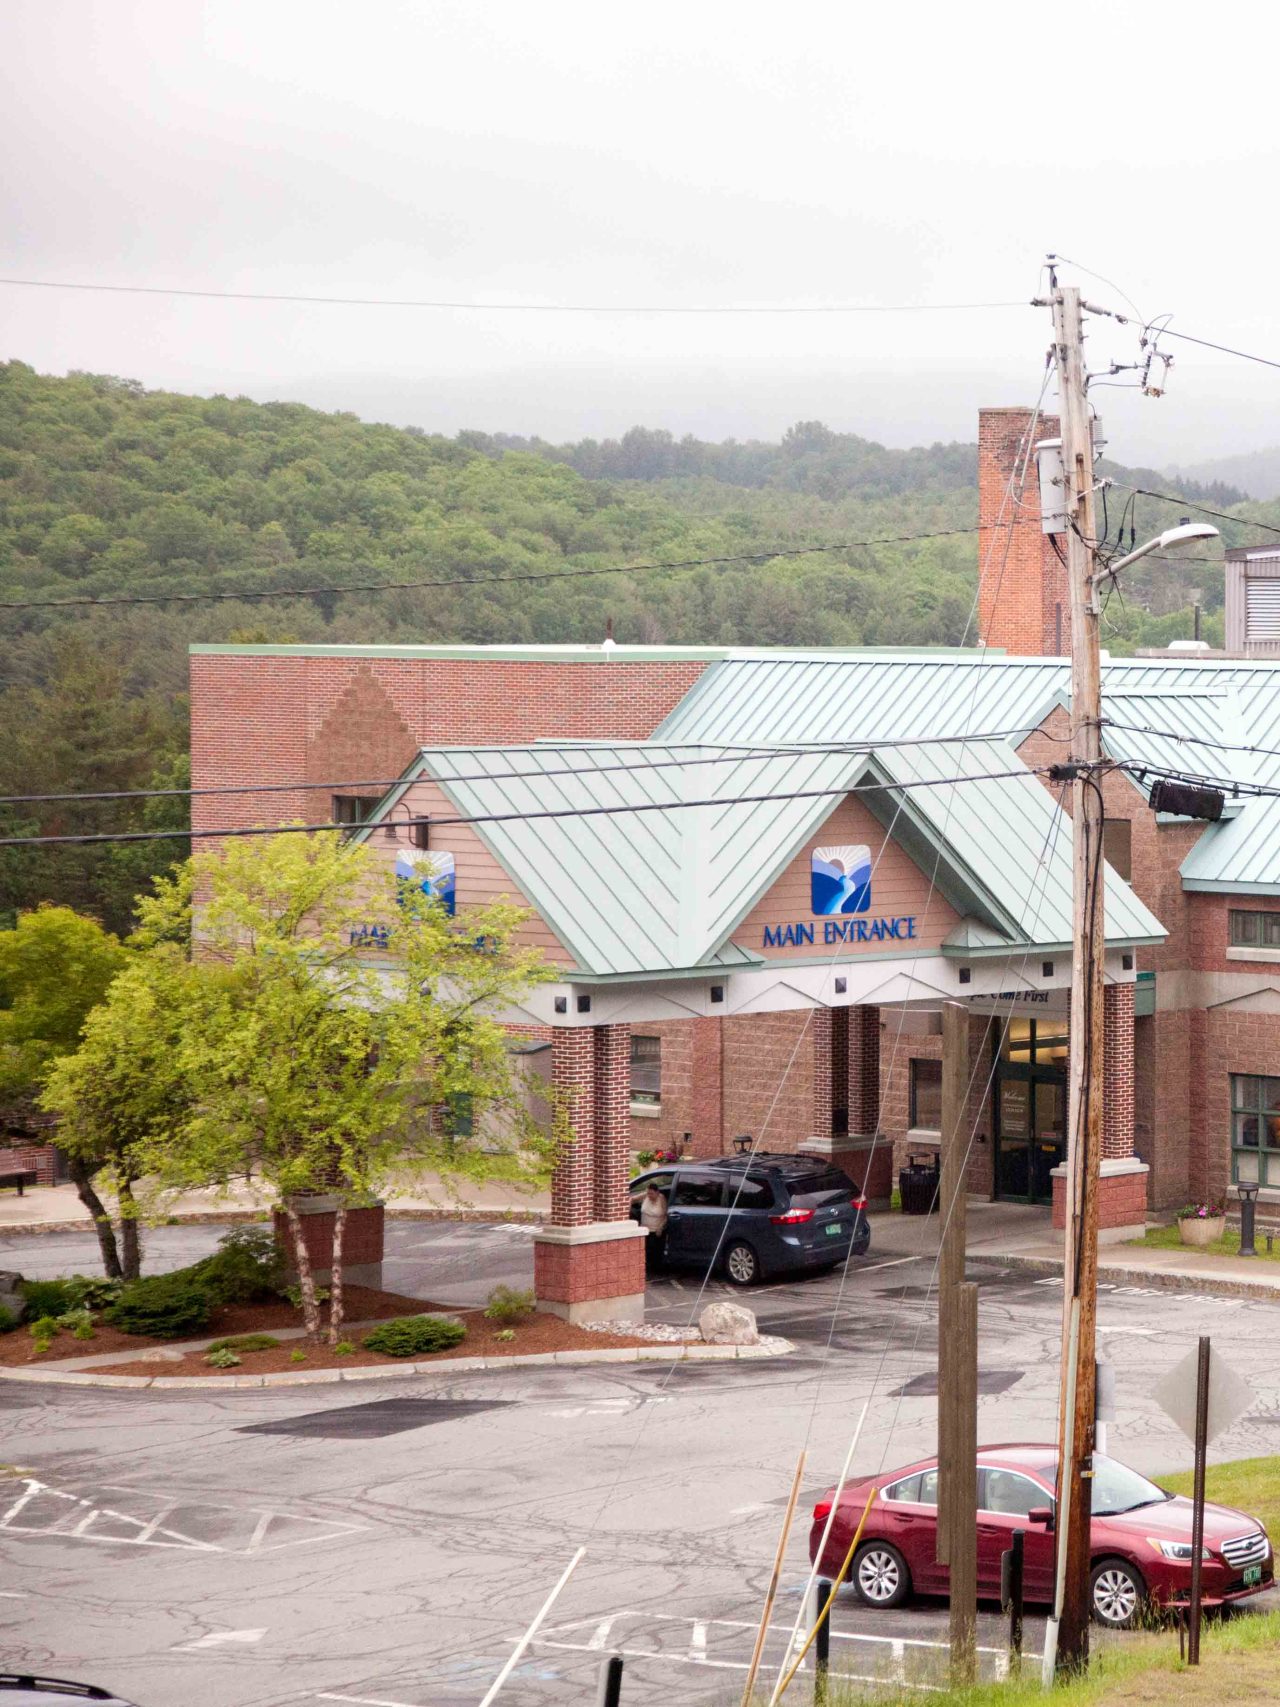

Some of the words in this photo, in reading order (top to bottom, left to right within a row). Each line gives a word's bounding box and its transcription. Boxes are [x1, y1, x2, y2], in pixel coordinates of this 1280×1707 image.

[763, 922, 815, 948] MAIN
[824, 917, 918, 945] ENTRANCE
[1023, 989, 1050, 1003] First
